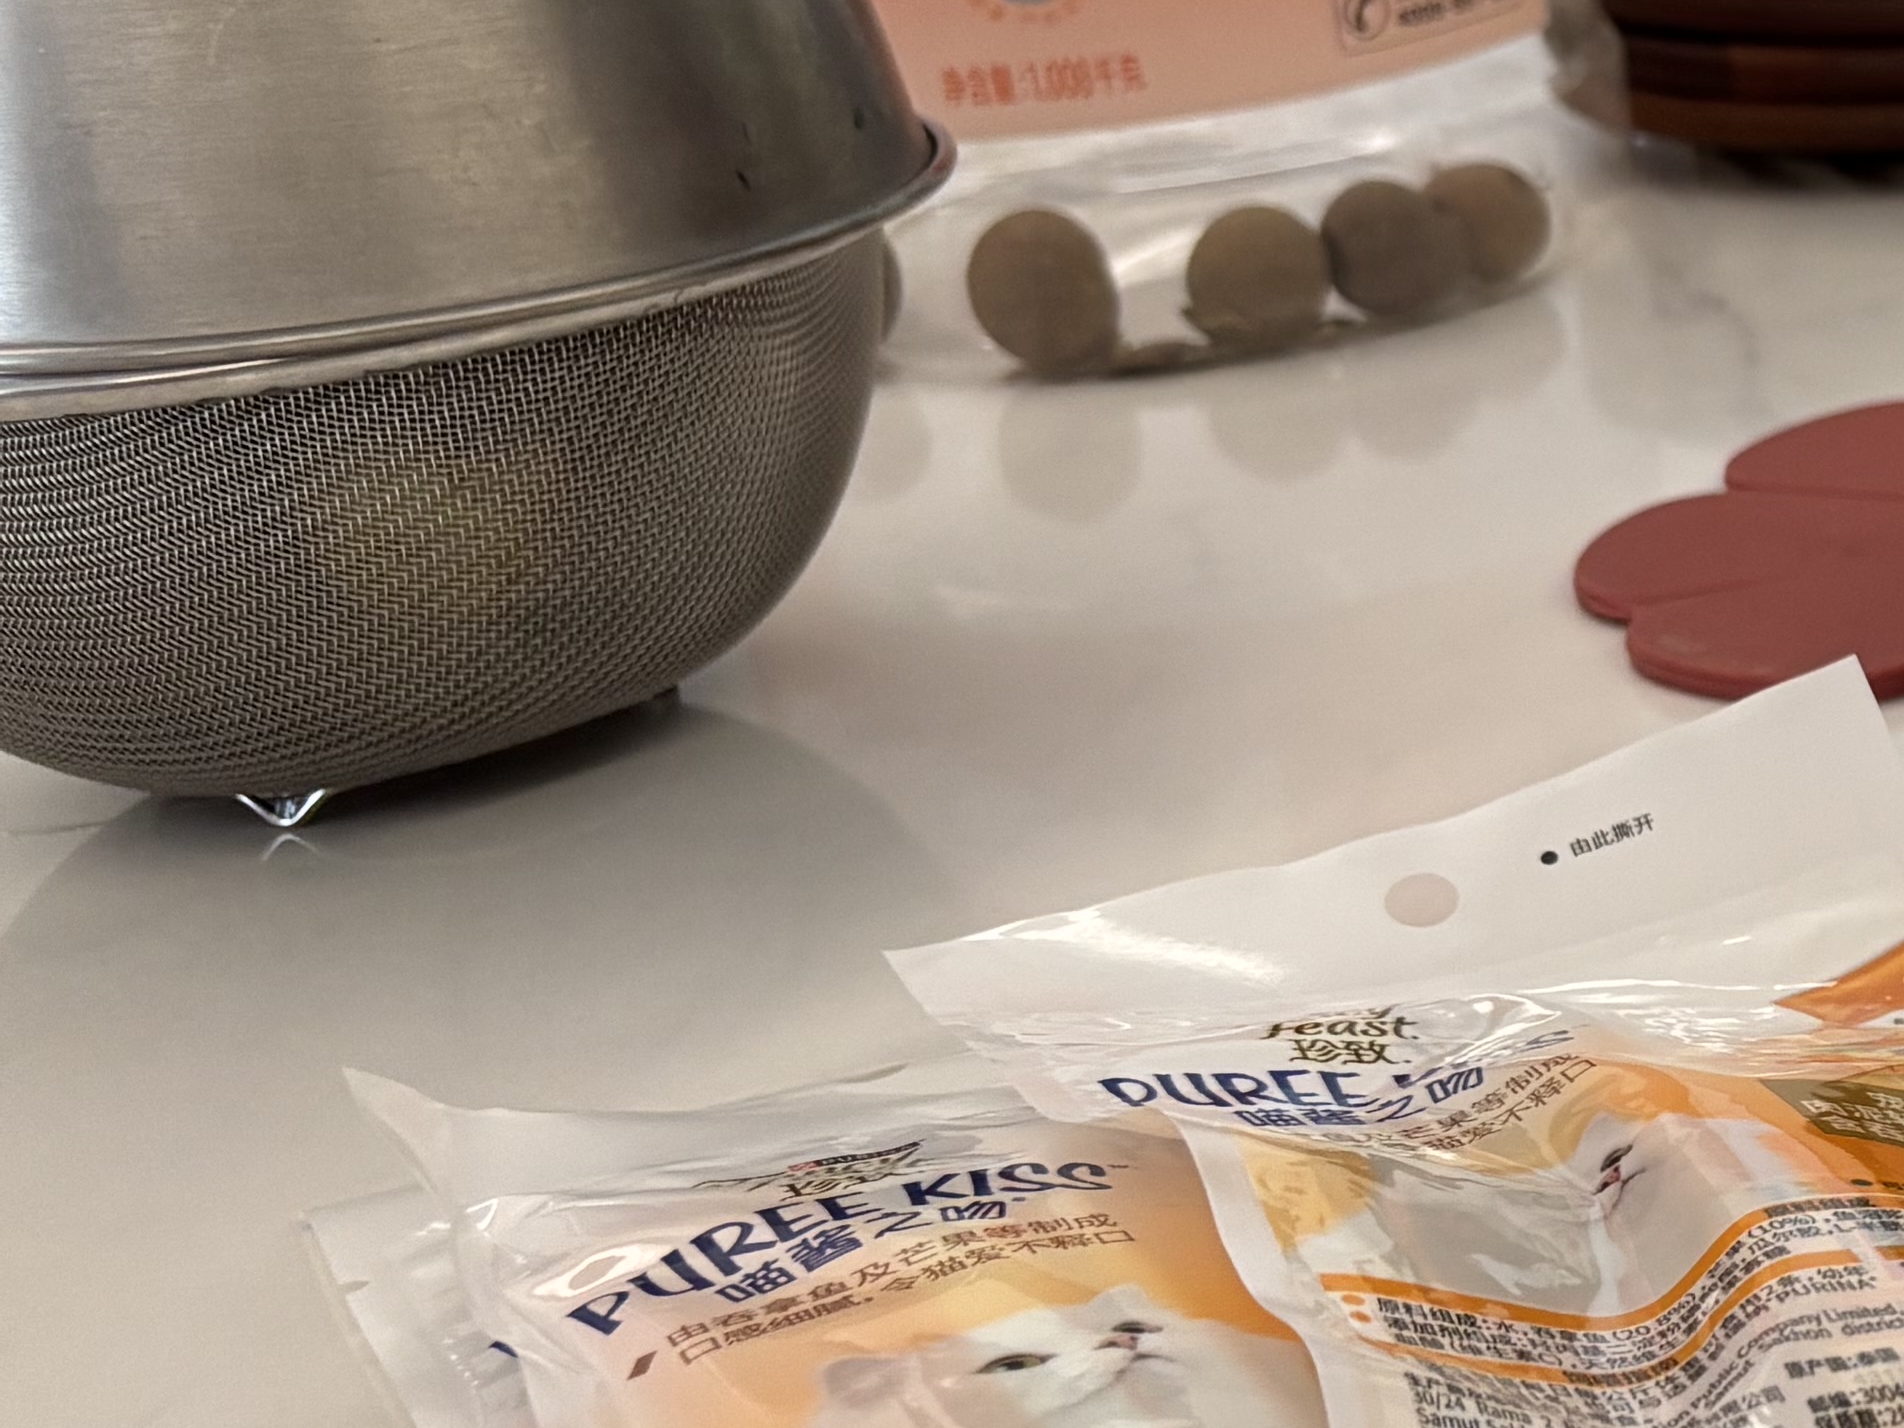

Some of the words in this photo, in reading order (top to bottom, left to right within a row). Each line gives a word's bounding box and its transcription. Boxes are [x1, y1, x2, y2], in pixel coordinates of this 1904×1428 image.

[1569, 811, 1655, 857] 由此撕开
[565, 1190, 869, 1336] PUREE
[905, 1159, 1114, 1206] KISS
[712, 1194, 1010, 1305] 喵酱之吻
